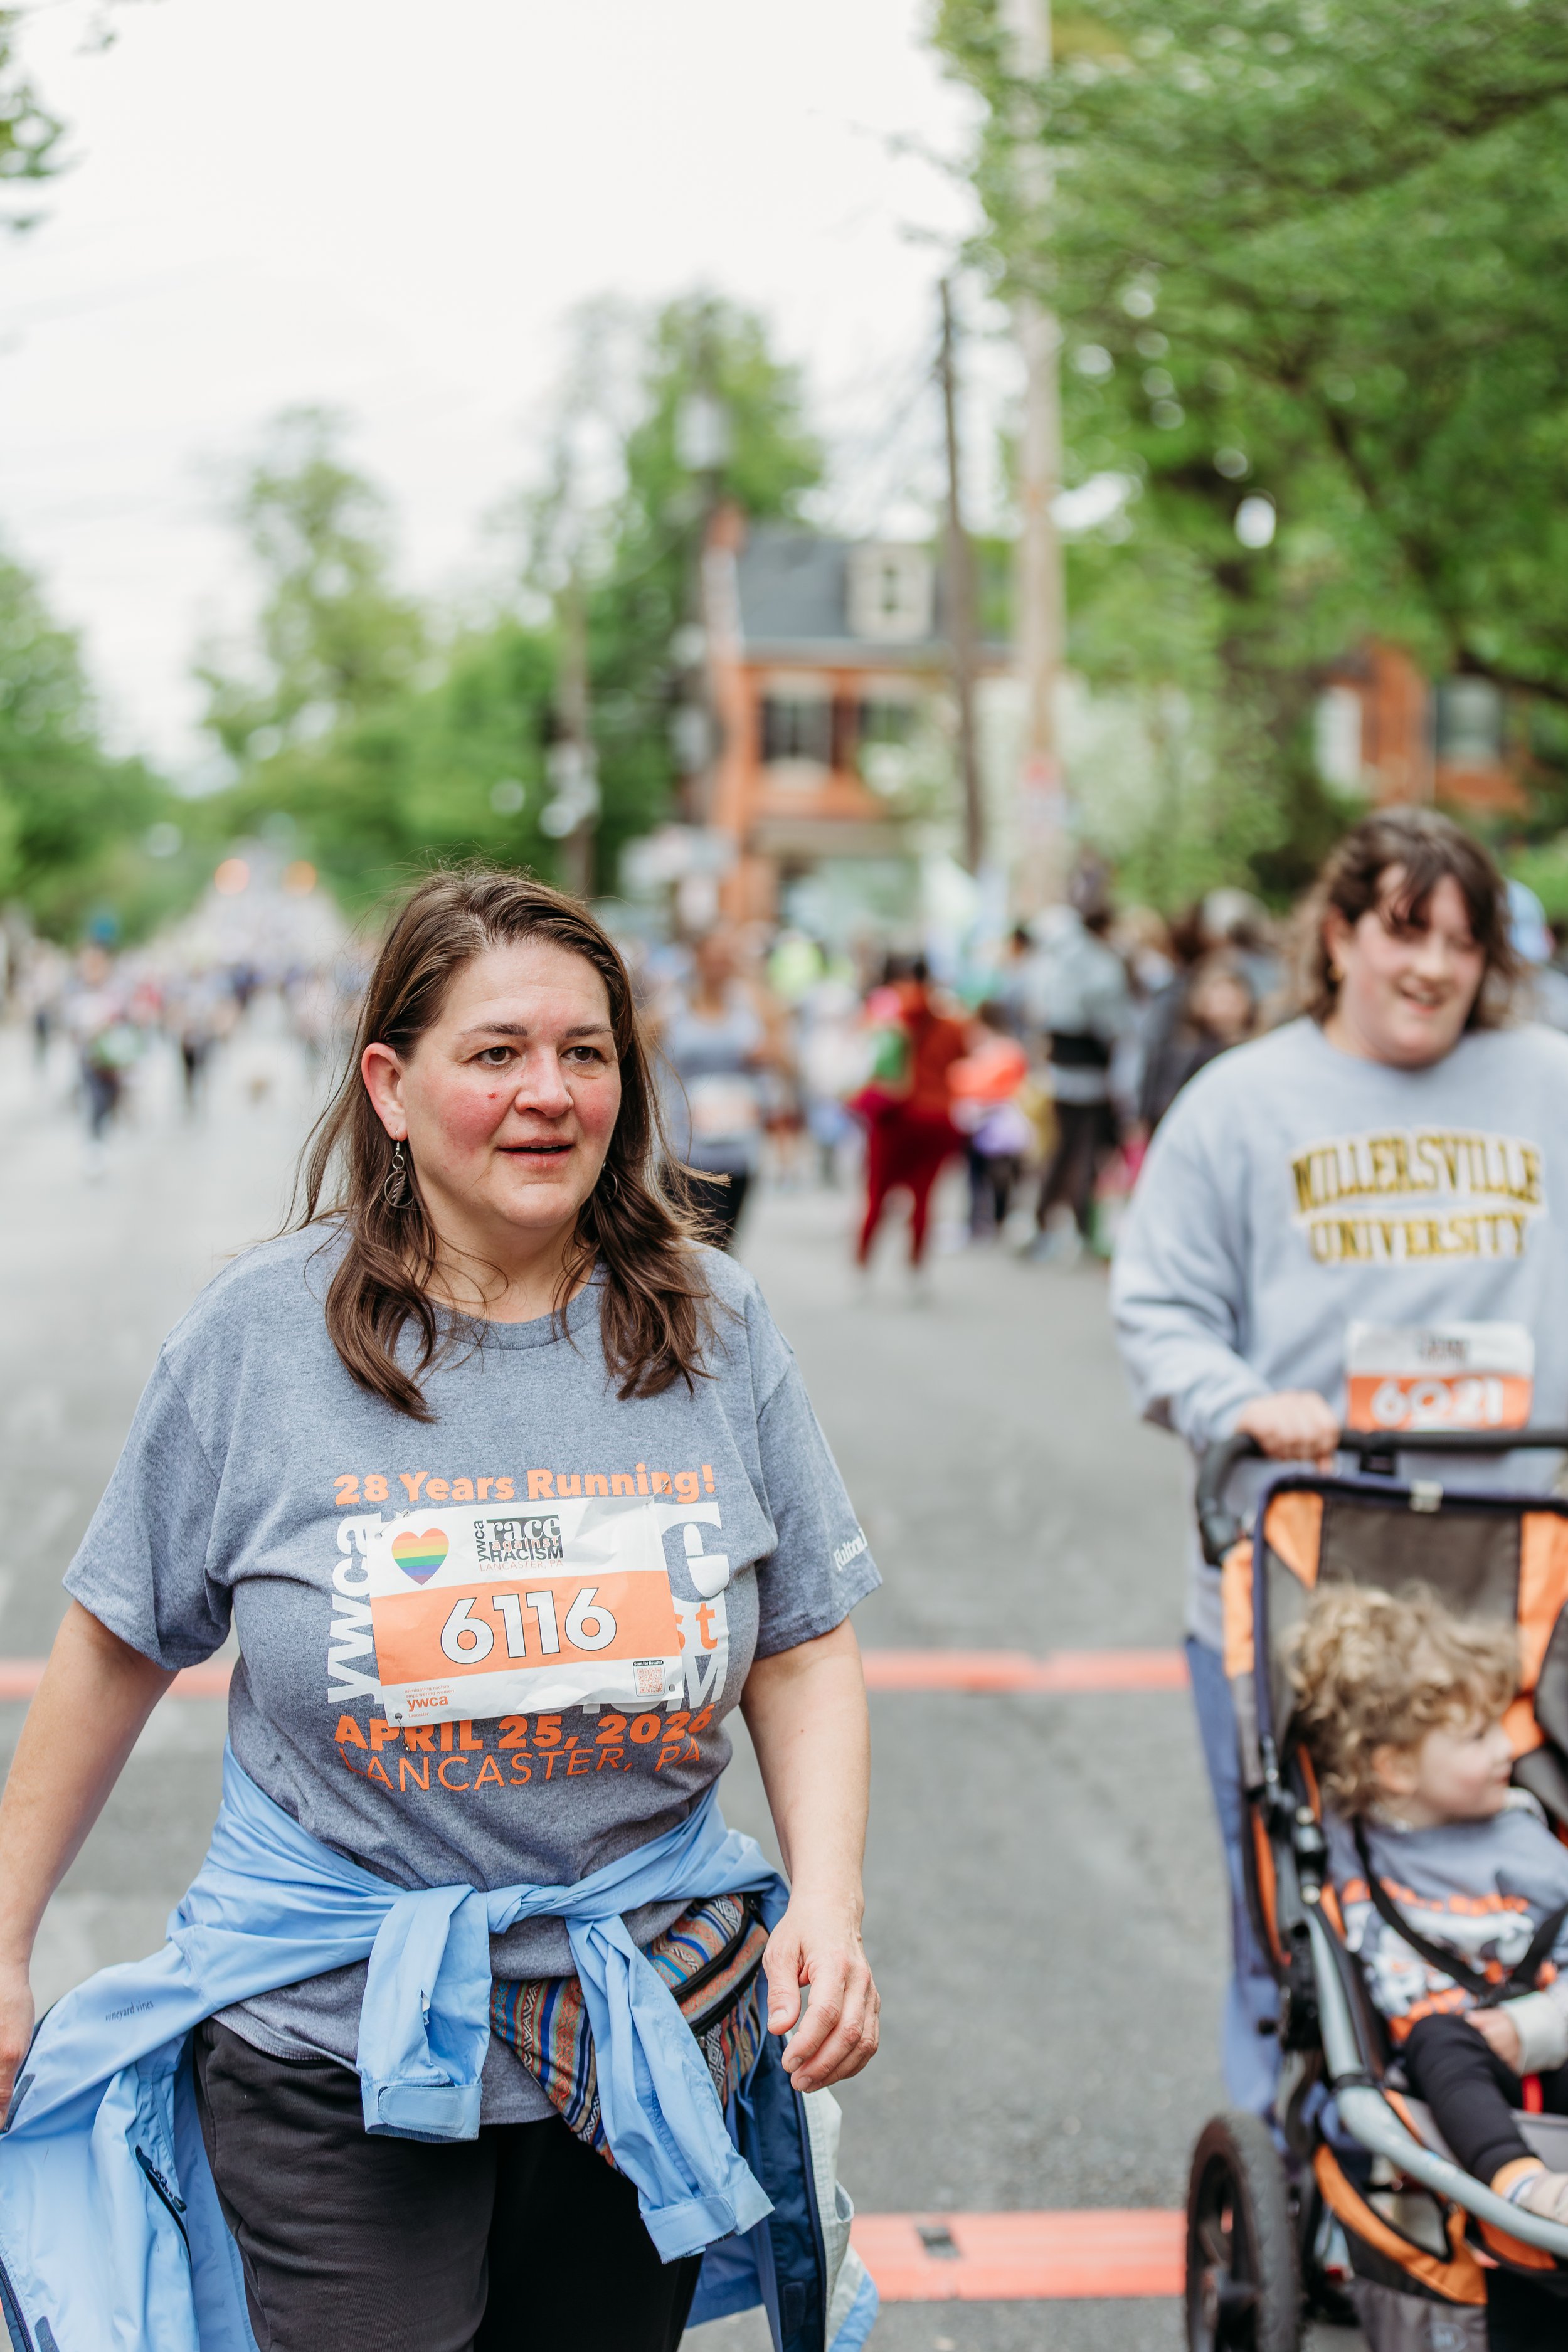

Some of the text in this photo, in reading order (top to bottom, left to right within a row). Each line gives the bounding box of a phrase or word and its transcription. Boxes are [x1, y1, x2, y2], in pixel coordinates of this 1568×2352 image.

[1291, 1131, 1542, 1216] MILLERSVILLE
[1309, 1210, 1525, 1263] UNIVERSITY
[333, 1463, 715, 1505] 28 Years Running!
[474, 1520, 490, 1562] ywca
[487, 1518, 561, 1542] race
[492, 1536, 559, 1553] against
[479, 1559, 563, 1572] LANCASTER, PA
[489, 1547, 564, 1563] RACISM
[440, 1587, 617, 1665] 6116
[407, 1695, 448, 1712] ywca
[334, 1703, 715, 1752] APRIL 25, 2026
[339, 1736, 700, 1793] LANCASTER, PA
[105, 2000, 154, 2022] vineyard vines
